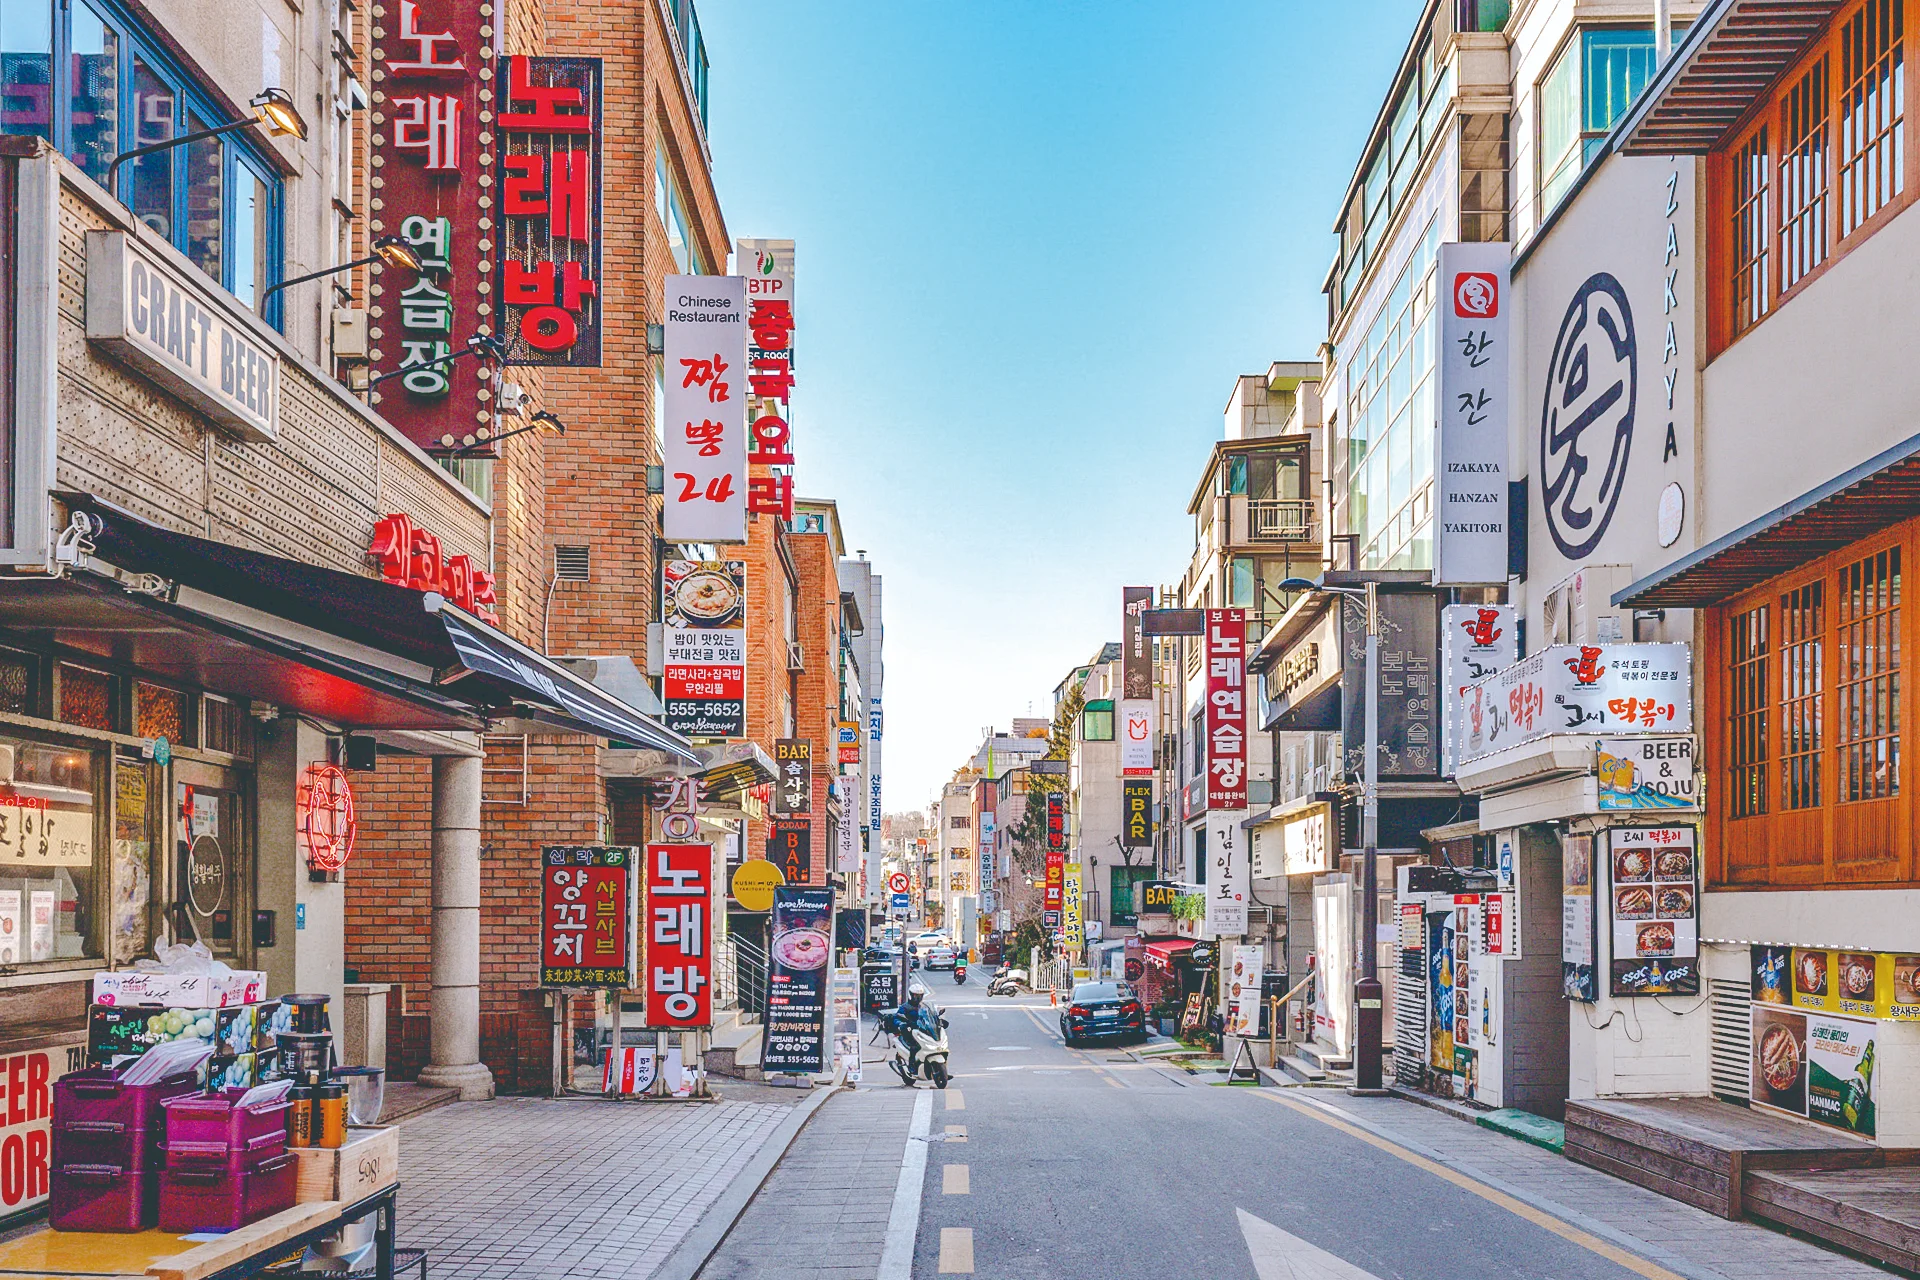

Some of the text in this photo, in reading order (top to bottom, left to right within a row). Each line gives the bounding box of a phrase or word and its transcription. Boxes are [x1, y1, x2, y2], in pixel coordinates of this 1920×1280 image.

[385, 0, 466, 396] 노래 연습장
[499, 54, 597, 352] 노래방
[749, 279, 783, 294] BTP
[678, 295, 731, 308] Chinese
[1663, 155, 1679, 463] ZAKAYA
[669, 310, 740, 323] Restaurant
[131, 259, 271, 420] CRAFT BEER
[1457, 330, 1494, 425] 한잔
[748, 300, 795, 521] 중국요리
[673, 353, 735, 502] 짬뽕 24
[1448, 463, 1500, 473] IZAKAYA
[1449, 493, 1498, 503] HANZAN
[1444, 523, 1502, 533] YAKITORI
[702, 633, 735, 646] 맛있는
[669, 649, 740, 660] 부대전골 맛집
[1382, 651, 1403, 695] 보노
[1612, 660, 1649, 669] 즉석 토핑
[1621, 671, 1679, 681] 떡볶이 전문점
[685, 683, 724, 694] 무한리필
[669, 703, 740, 716] 555-5652
[1211, 626, 1245, 788] 노래연습장
[1407, 651, 1430, 768] 노래연습장
[1509, 681, 1544, 731] 떡볶이
[1561, 697, 1676, 728] 고씨 떡볶이
[870, 718, 882, 741] 치과
[778, 744, 809, 759] BAR
[1643, 742, 1691, 759] BEER
[1659, 762, 1673, 777] &
[1125, 788, 1150, 796] FLEX
[1644, 780, 1693, 796] SOJU
[870, 774, 882, 831] 산후조리원
[778, 821, 809, 829] SODAM
[1048, 801, 1063, 847] 노래방
[1130, 799, 1146, 838] BAR
[1624, 829, 1681, 844] 고씨 떡볶이
[607, 852, 621, 863] 2F
[786, 833, 800, 880] BAR
[1217, 824, 1234, 899] 김일도
[1047, 867, 1061, 905] 호프
[1146, 888, 1176, 905] BAR
[1065, 879, 1079, 944] 탐라도야지
[1488, 901, 1502, 914] BEER
[553, 869, 588, 965] 양꼬치
[595, 881, 617, 954] 샤브샤브
[651, 851, 705, 1018] 노래방
[1487, 932, 1501, 947] SOJU
[870, 976, 892, 987] 소담
[111, 1020, 142, 1038] 샤인
[787, 1055, 820, 1064] 555-5652
[1809, 1094, 1841, 1112] HANMAC
